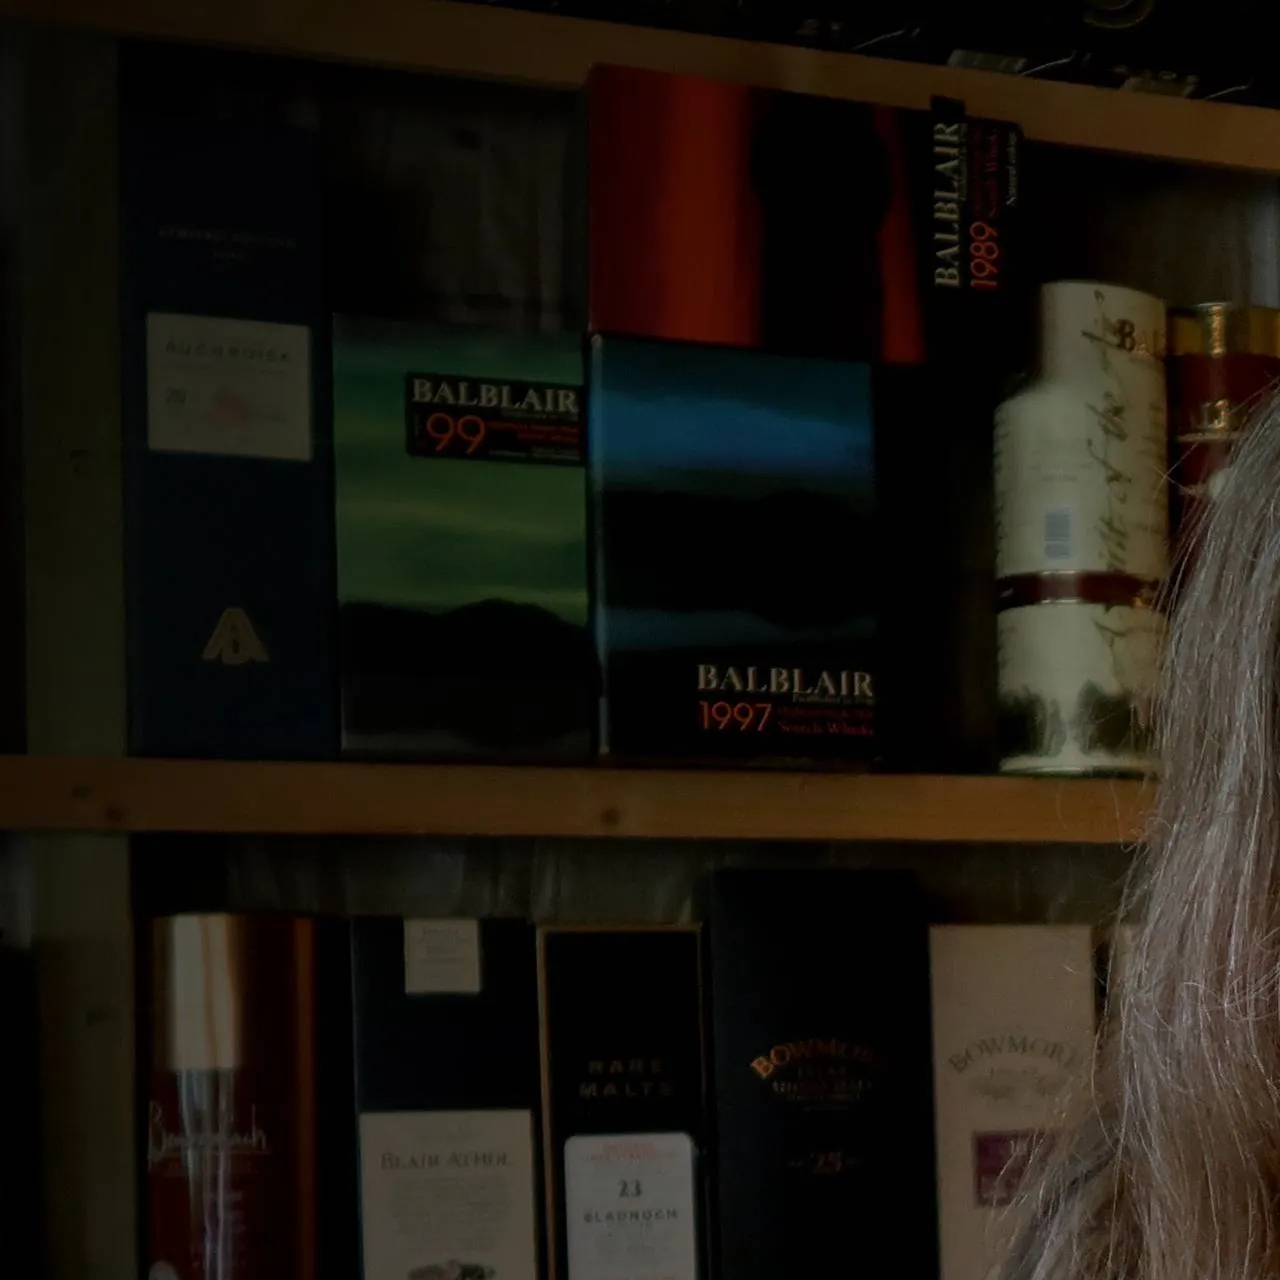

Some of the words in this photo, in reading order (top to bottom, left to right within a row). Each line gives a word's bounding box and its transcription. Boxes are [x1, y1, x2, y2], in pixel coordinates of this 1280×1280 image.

[933, 122, 961, 288] BALBLAIR
[970, 220, 999, 288] 1989
[412, 377, 580, 413] BALBLAIR
[426, 412, 486, 455] 99
[697, 663, 874, 698] BALBLAIR
[700, 700, 772, 732] 1997
[381, 1150, 440, 1170] BLAIR
[617, 1178, 643, 1199] 23
